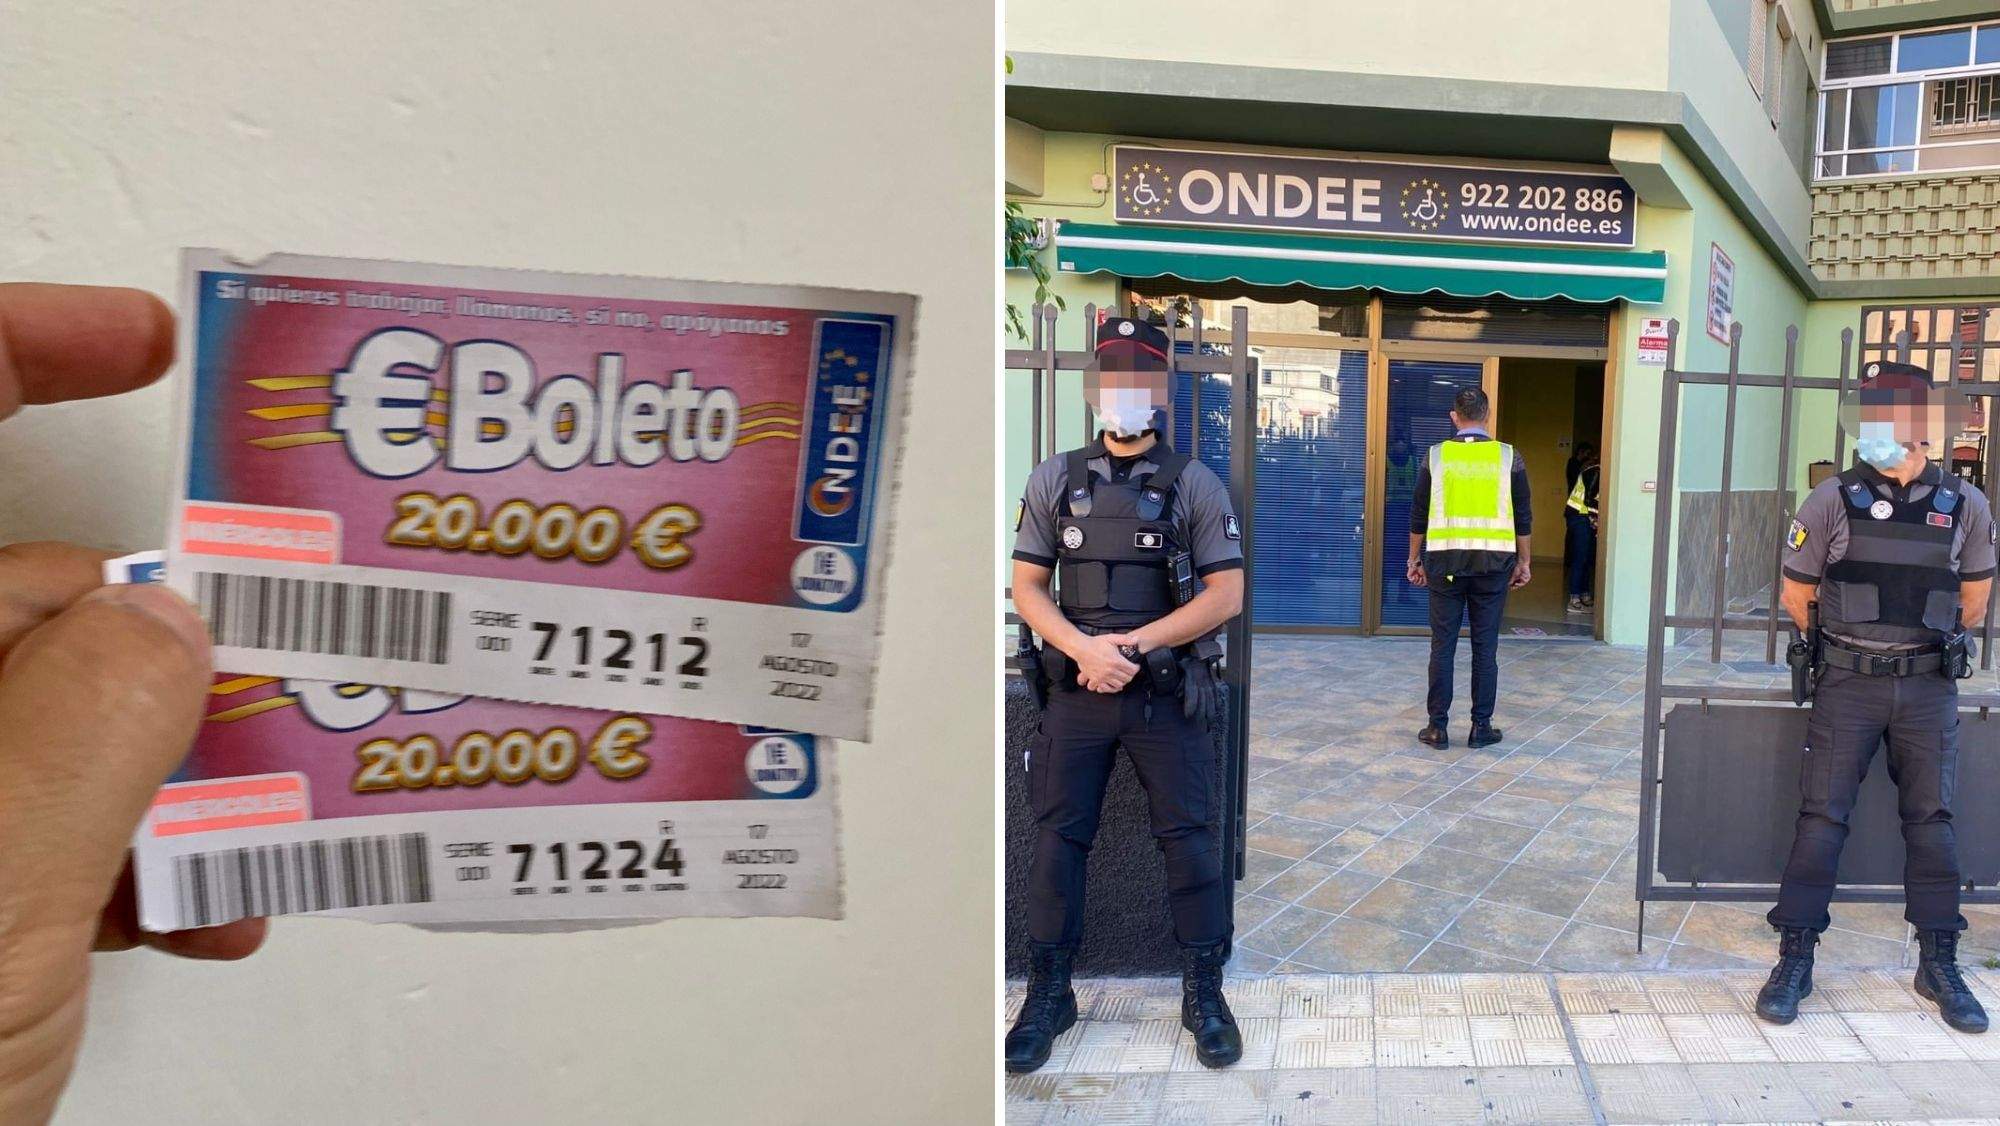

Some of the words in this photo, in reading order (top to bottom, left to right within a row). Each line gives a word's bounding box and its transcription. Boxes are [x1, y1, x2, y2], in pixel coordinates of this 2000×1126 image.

[1178, 168, 1382, 223] ONDEE
[1460, 181, 1510, 208] 922
[1518, 184, 1567, 211] 202
[1574, 187, 1624, 214] 886
[1460, 213, 1623, 235] www.ondee.es
[248, 283, 341, 307] quieres
[806, 384, 871, 518] ONDEE
[384, 491, 625, 564] 20.000
[631, 503, 703, 569] €
[469, 610, 521, 629] SERIE
[529, 621, 711, 677] 71212
[790, 632, 813, 648] 17
[758, 655, 839, 677] AGOSTO
[768, 679, 822, 701] 2022
[352, 727, 580, 793] 20.000
[588, 714, 655, 780] €
[747, 824, 769, 840] 17
[443, 841, 494, 859] SERIE
[506, 838, 687, 882] 71224
[721, 848, 800, 865] AGOSTO
[735, 873, 788, 889] 2022
